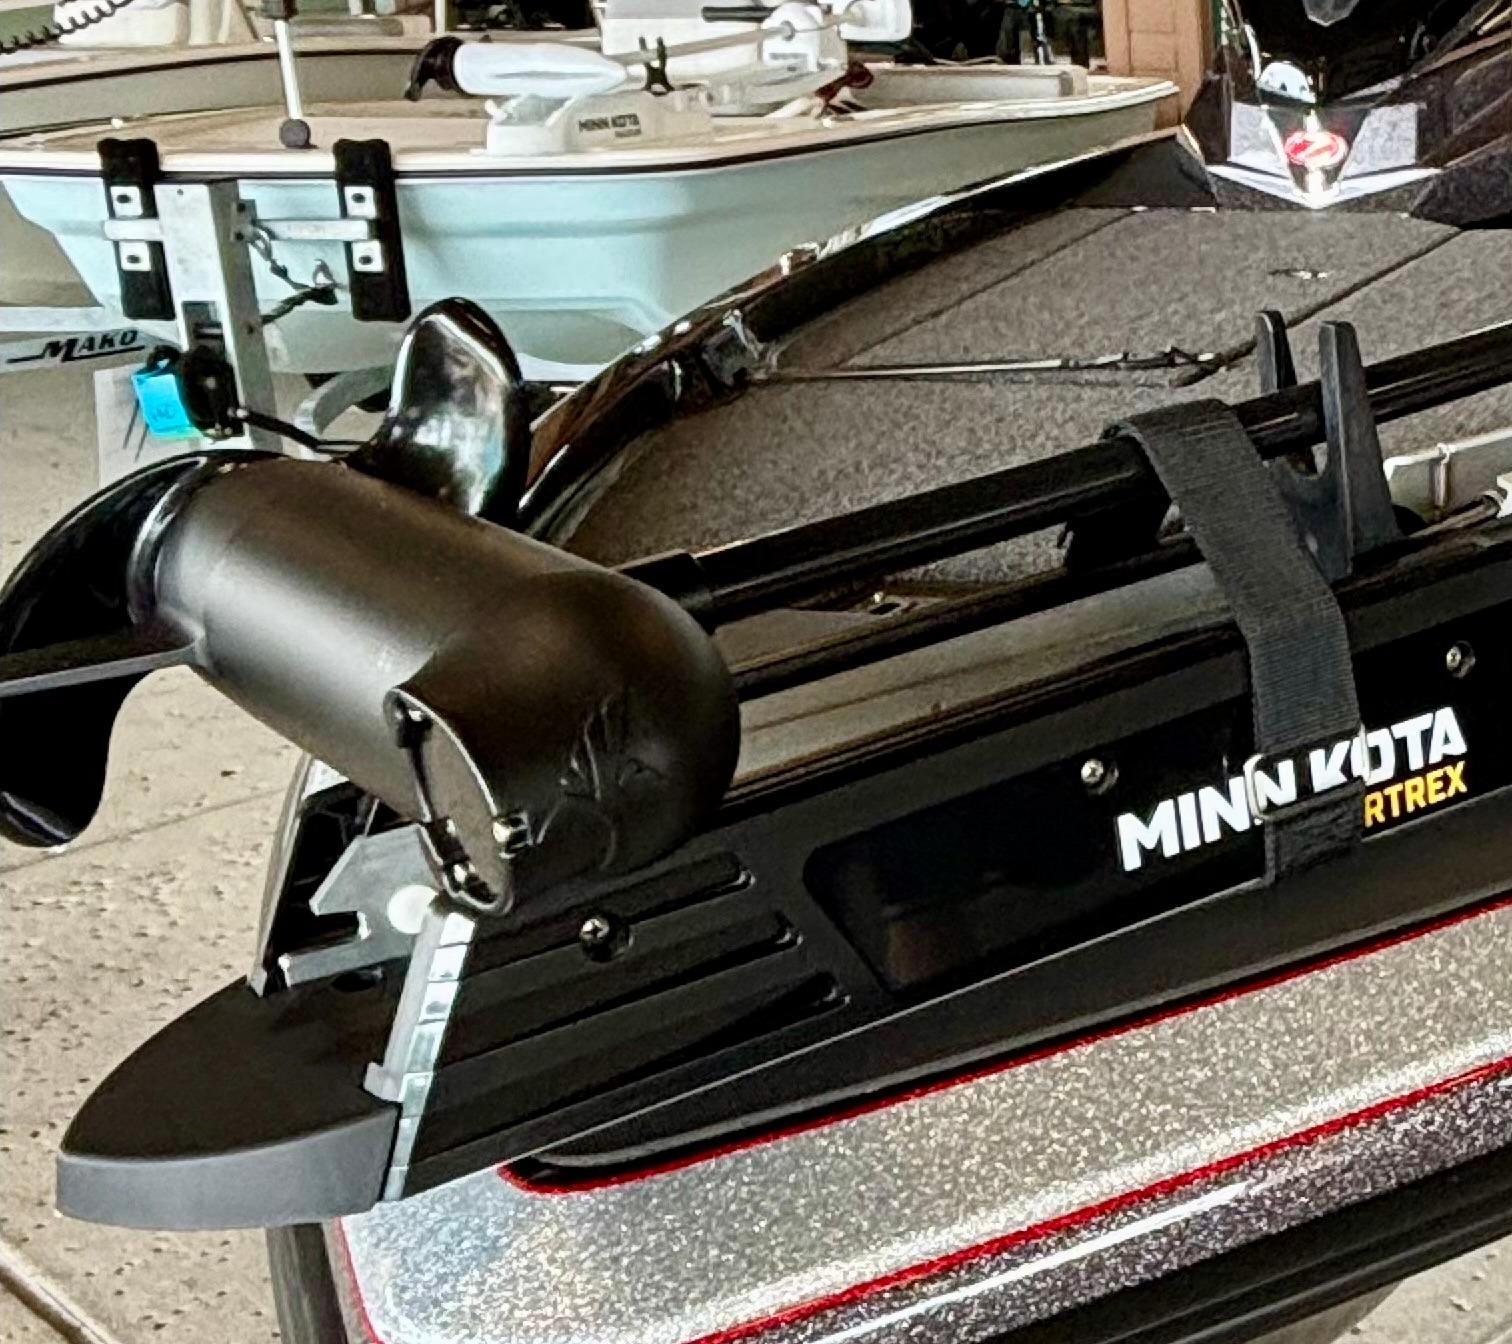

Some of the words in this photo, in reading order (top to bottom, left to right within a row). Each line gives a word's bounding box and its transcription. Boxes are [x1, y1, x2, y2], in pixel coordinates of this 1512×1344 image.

[6, 329, 145, 363] MAKO
[1116, 759, 1298, 872] MINN
[1308, 706, 1469, 794] KOTA
[1363, 760, 1469, 828] RTREX
